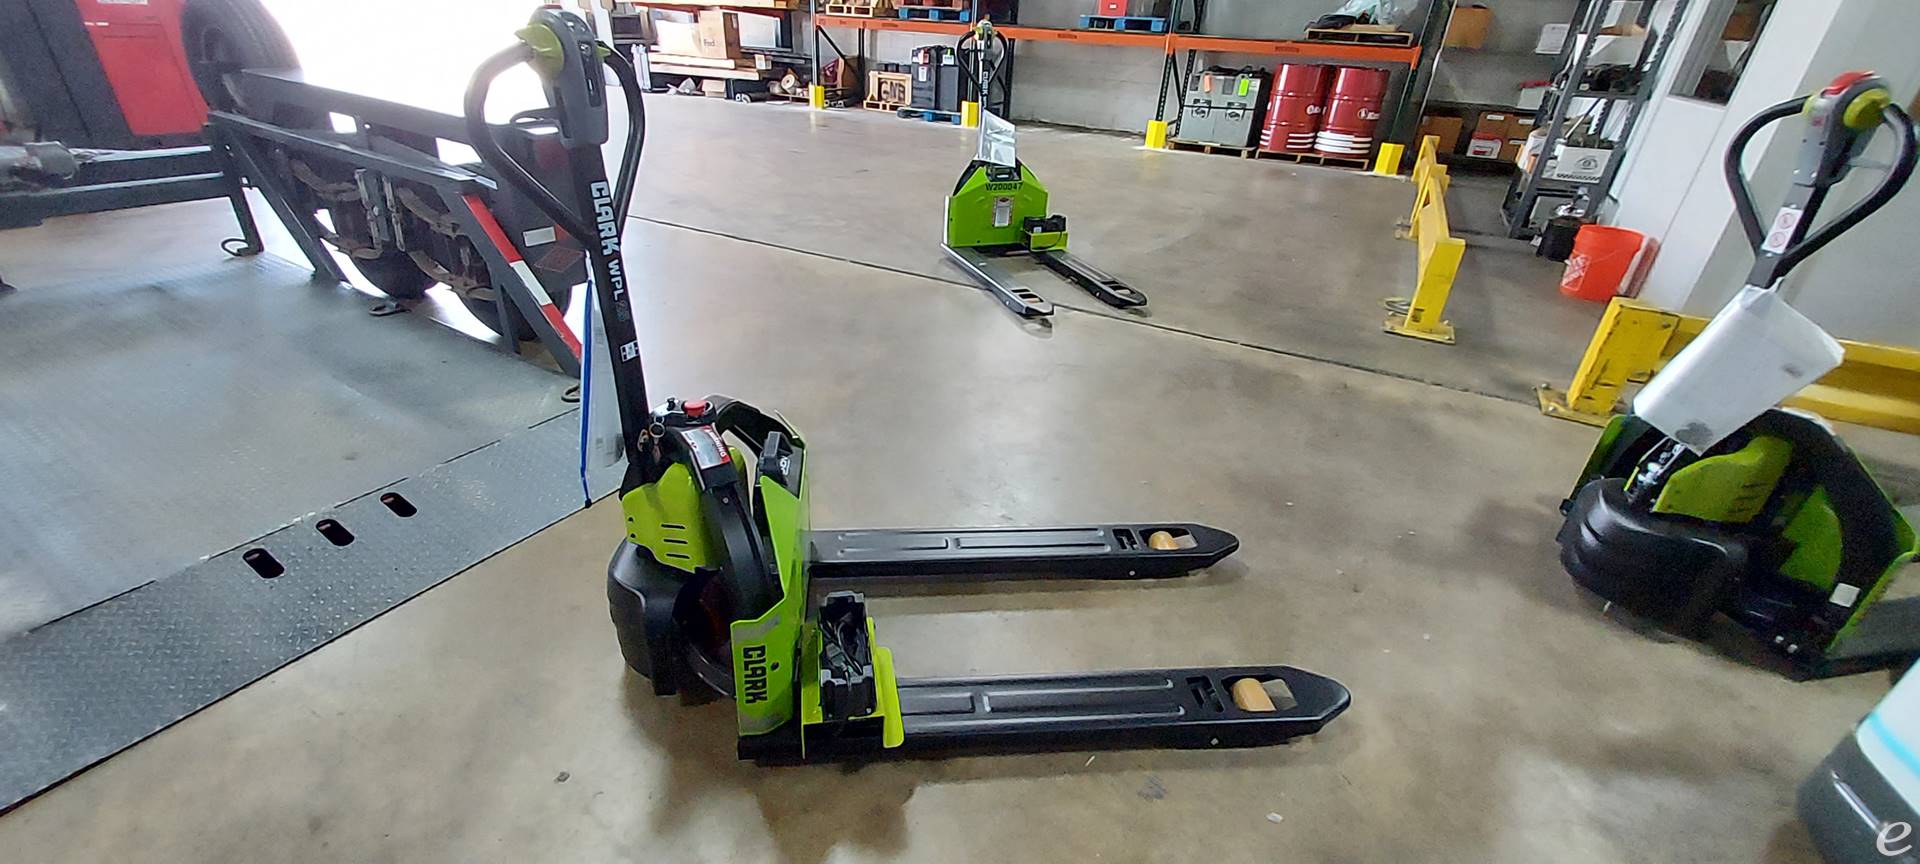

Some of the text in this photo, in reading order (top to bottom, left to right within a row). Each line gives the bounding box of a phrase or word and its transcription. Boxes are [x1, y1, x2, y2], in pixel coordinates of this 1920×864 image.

[590, 181, 621, 256] CLARK
[608, 259, 625, 301] WPL
[743, 645, 768, 704] CLARK
